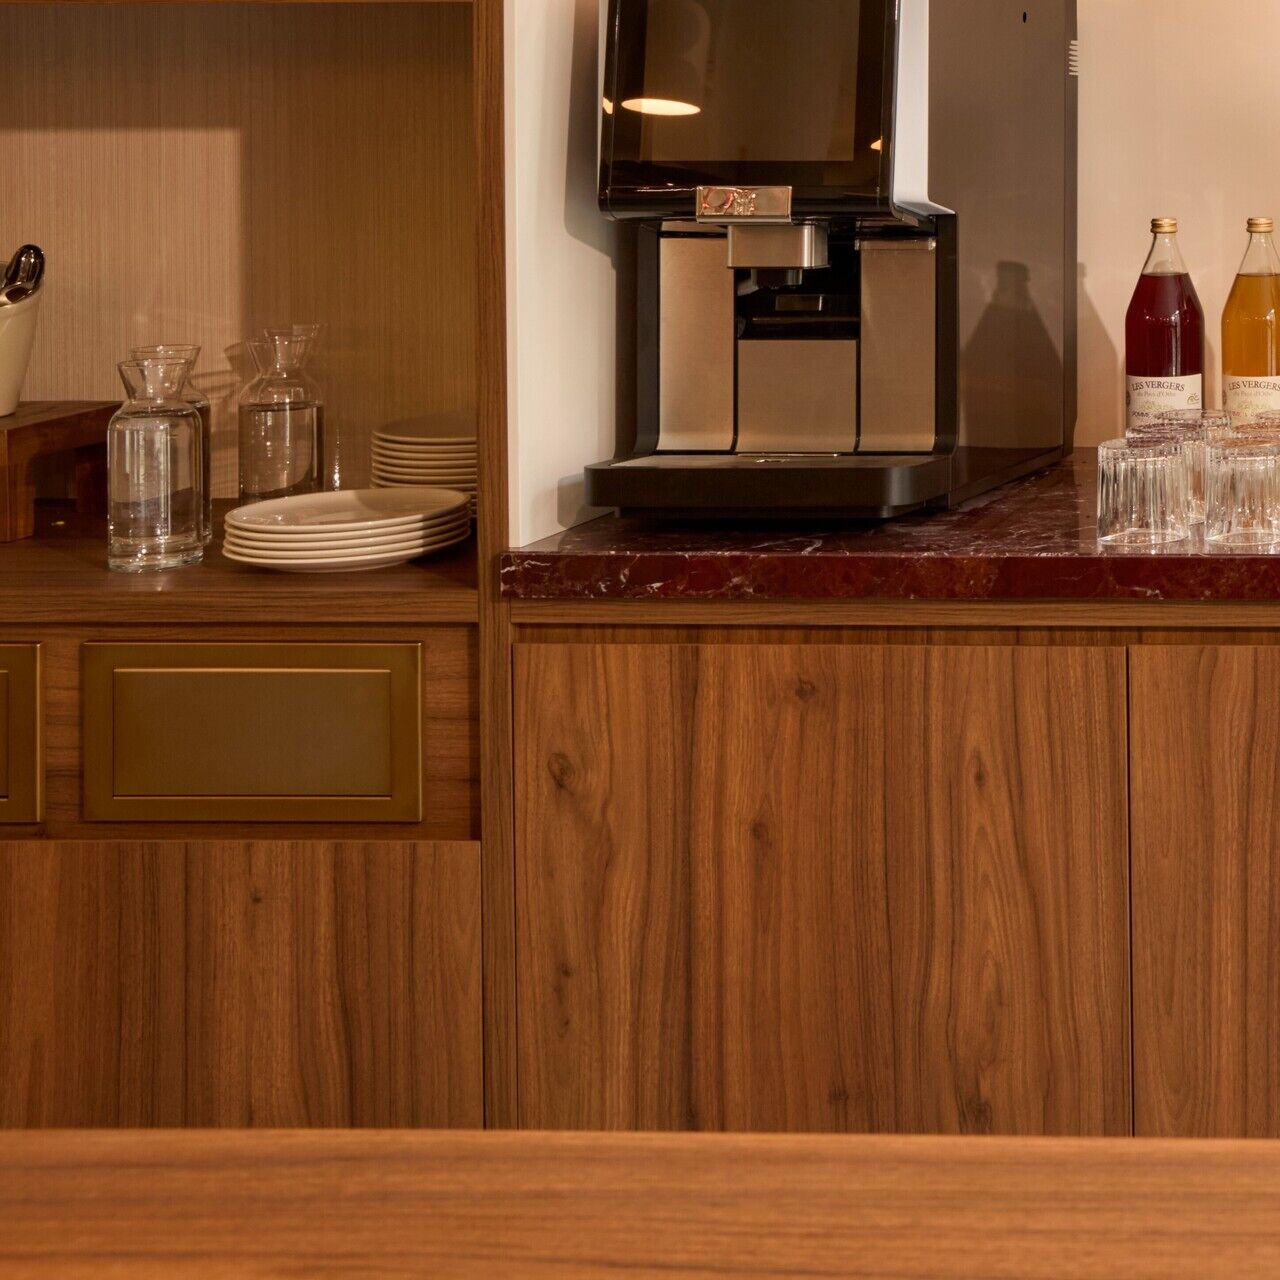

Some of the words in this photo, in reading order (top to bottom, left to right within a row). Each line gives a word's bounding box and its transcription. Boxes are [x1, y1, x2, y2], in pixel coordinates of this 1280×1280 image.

[1131, 381, 1144, 391] LES
[1144, 380, 1185, 392] VERGERS
[1229, 381, 1241, 391] LES
